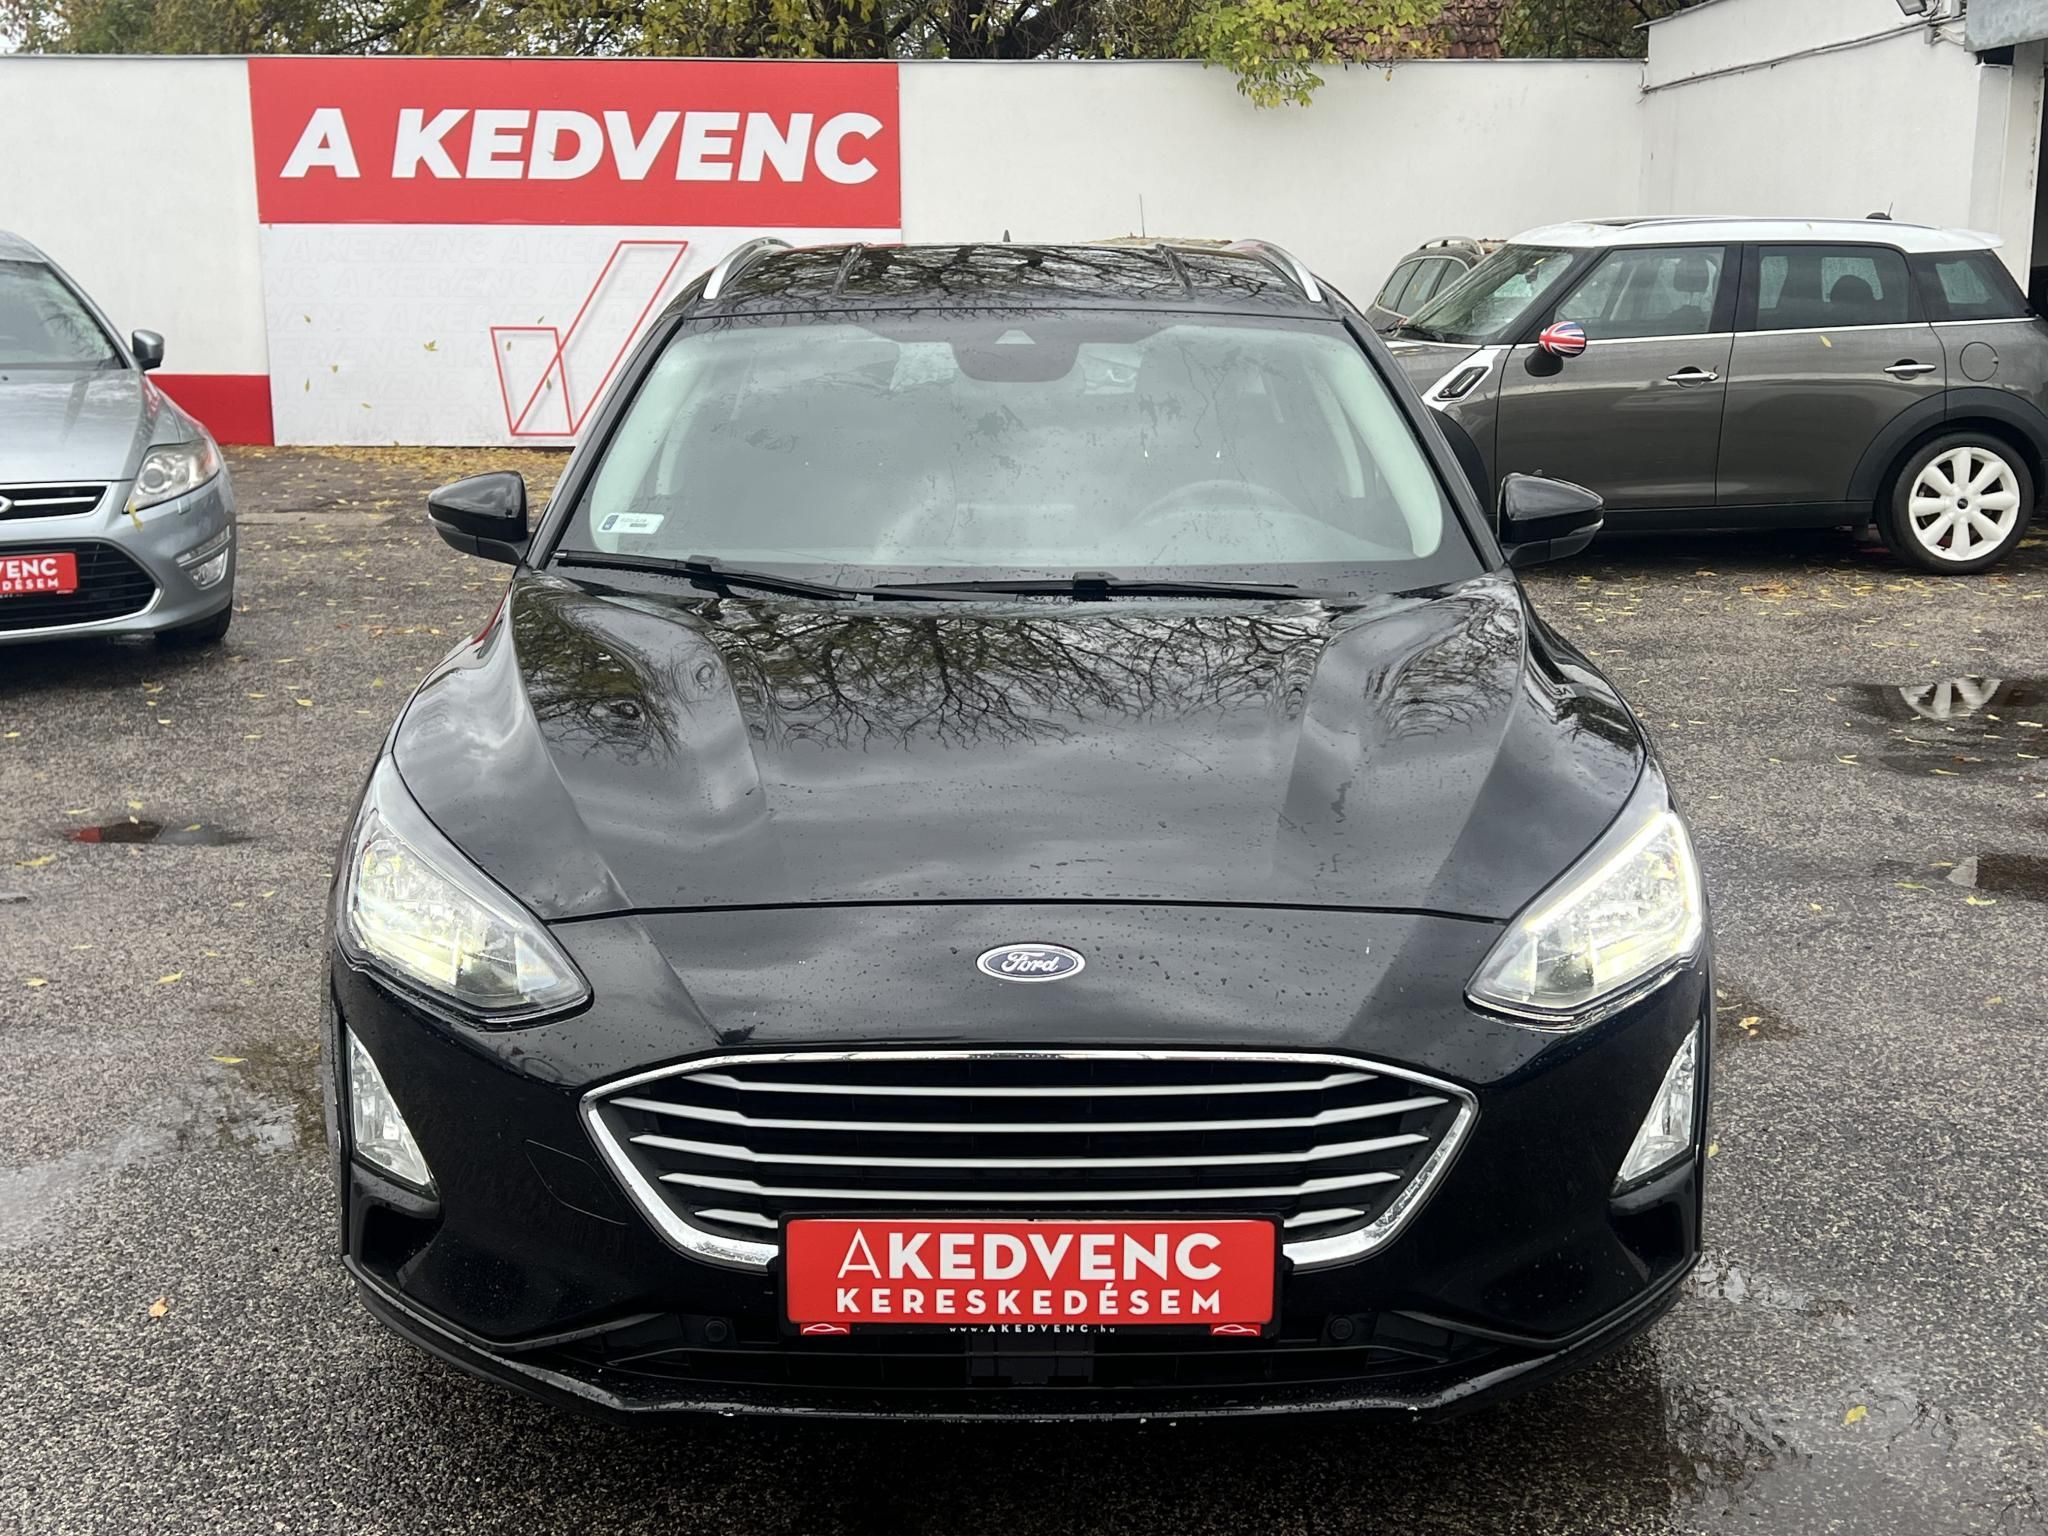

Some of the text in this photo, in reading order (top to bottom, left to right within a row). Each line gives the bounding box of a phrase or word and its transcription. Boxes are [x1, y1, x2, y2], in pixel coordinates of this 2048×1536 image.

[279, 107, 884, 185] A KEDVENC
[1001, 951, 1060, 973] Ford
[836, 1282, 1221, 1315] KERESKEDÉSEM
[949, 1323, 1116, 1334] www.AKEDVENC.hu
